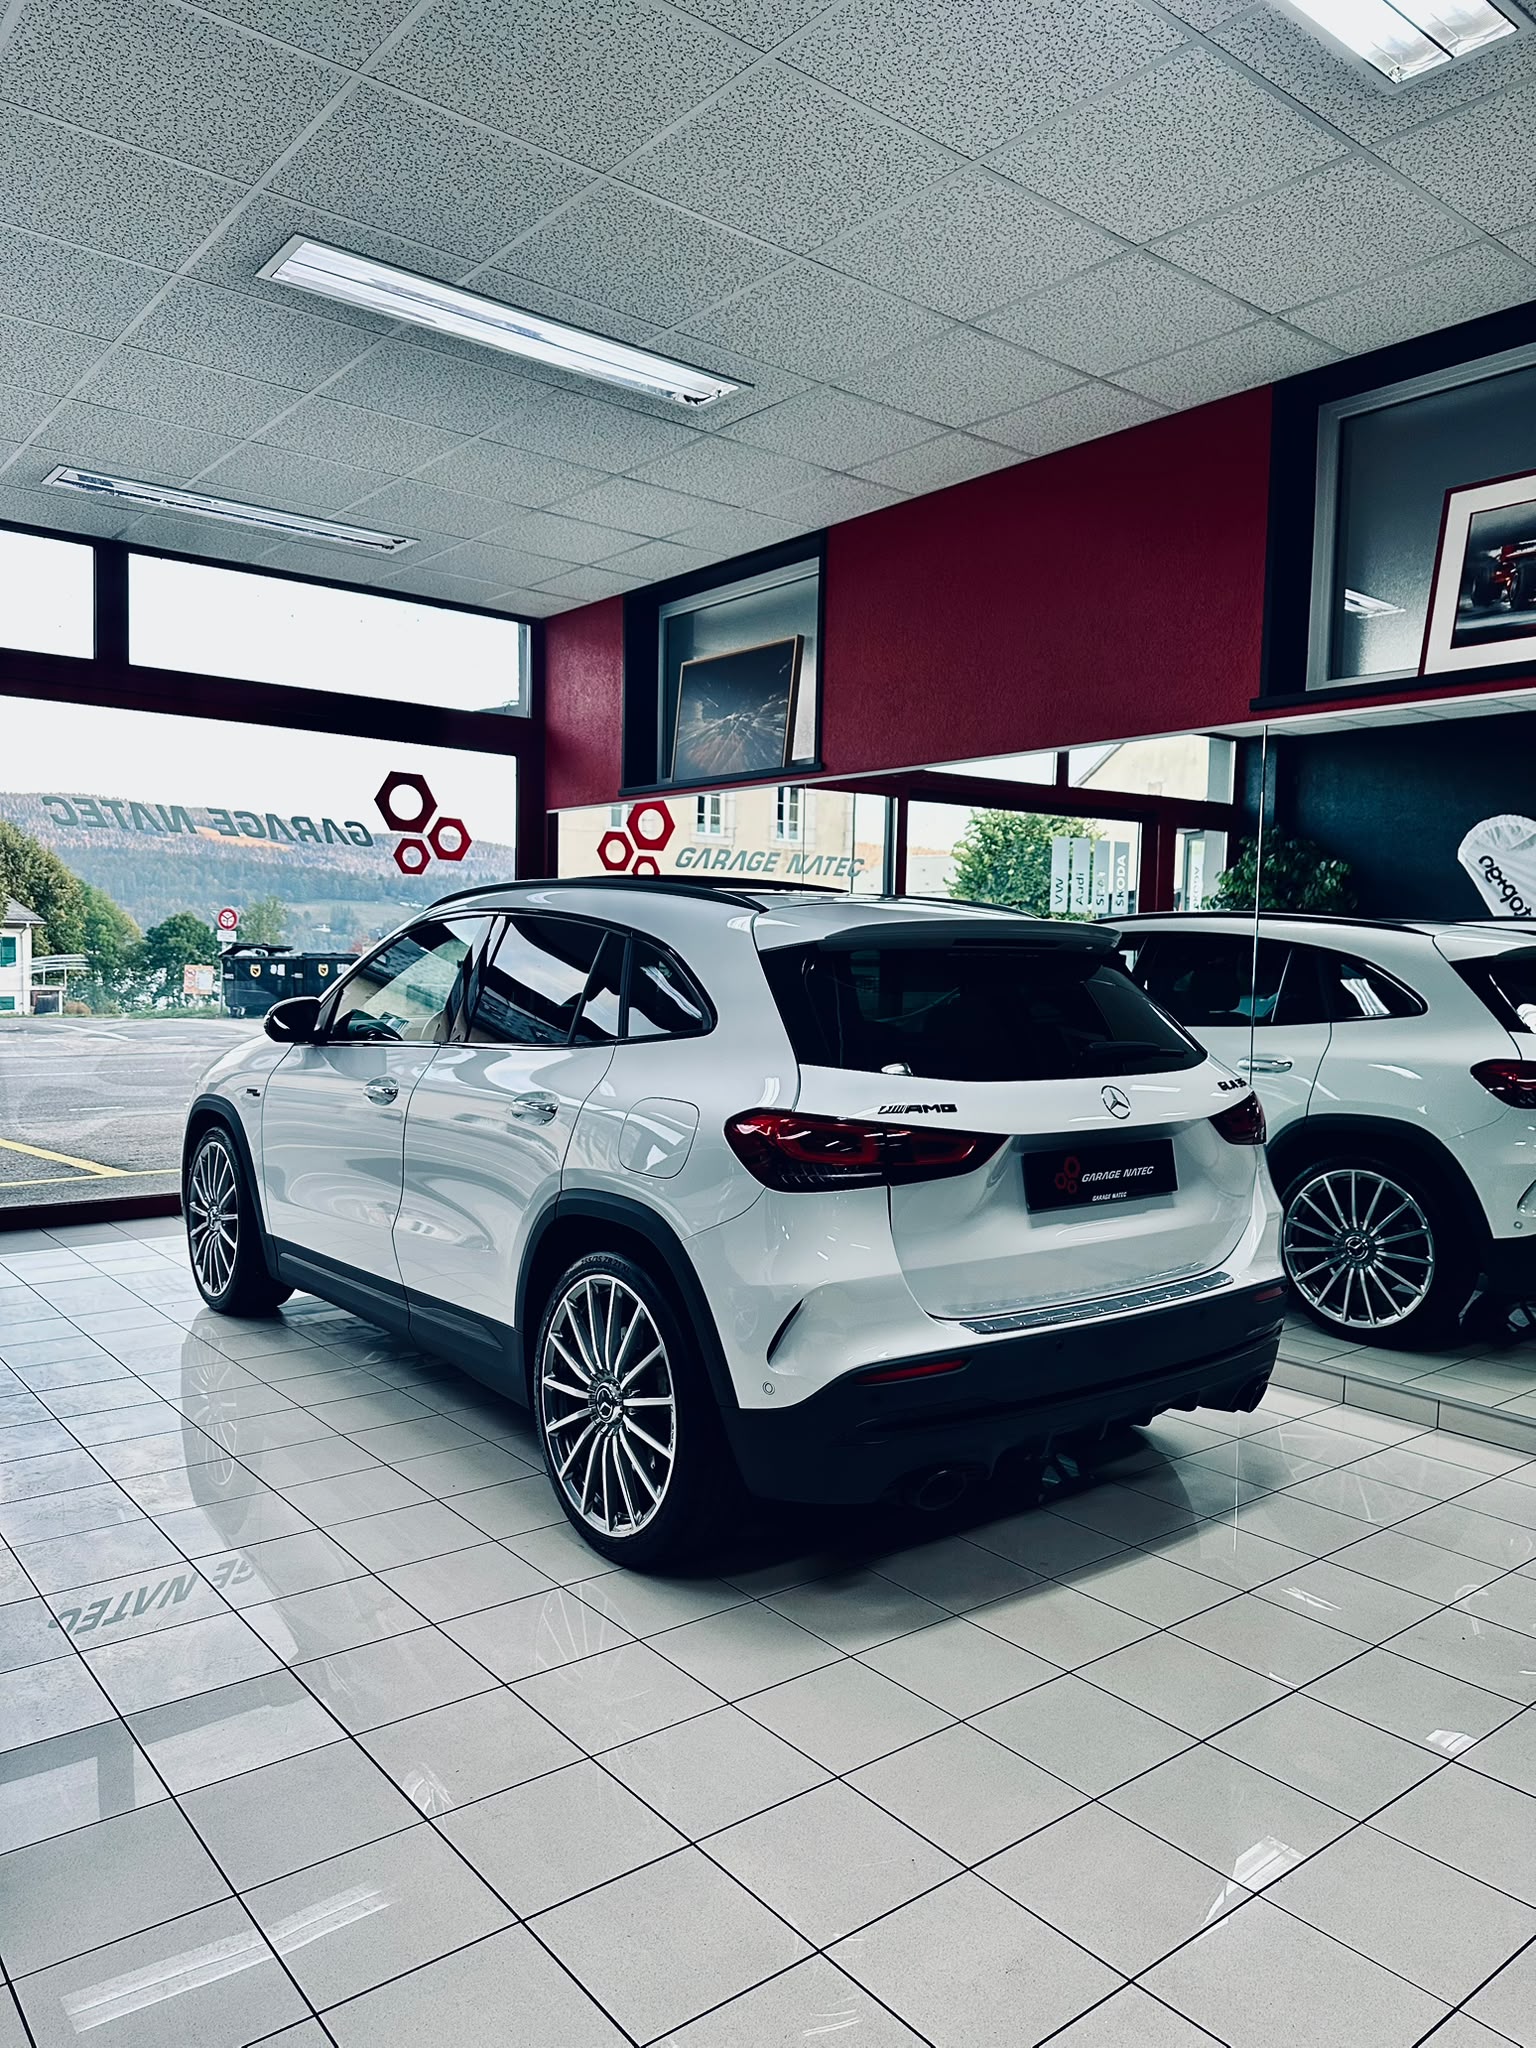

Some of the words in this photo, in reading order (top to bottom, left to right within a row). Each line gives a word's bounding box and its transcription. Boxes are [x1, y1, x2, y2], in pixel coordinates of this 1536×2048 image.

[675, 847, 781, 873] GARAGE
[786, 853, 865, 878] NATEC
[1054, 877, 1064, 905] VW
[1075, 872, 1085, 906] Audi
[904, 1103, 958, 1114] AMG
[1081, 1169, 1122, 1183] GARAGE
[1123, 1165, 1155, 1178] NATEC
[1092, 1193, 1111, 1201] GARAGE
[1112, 1191, 1127, 1199] NATEC
